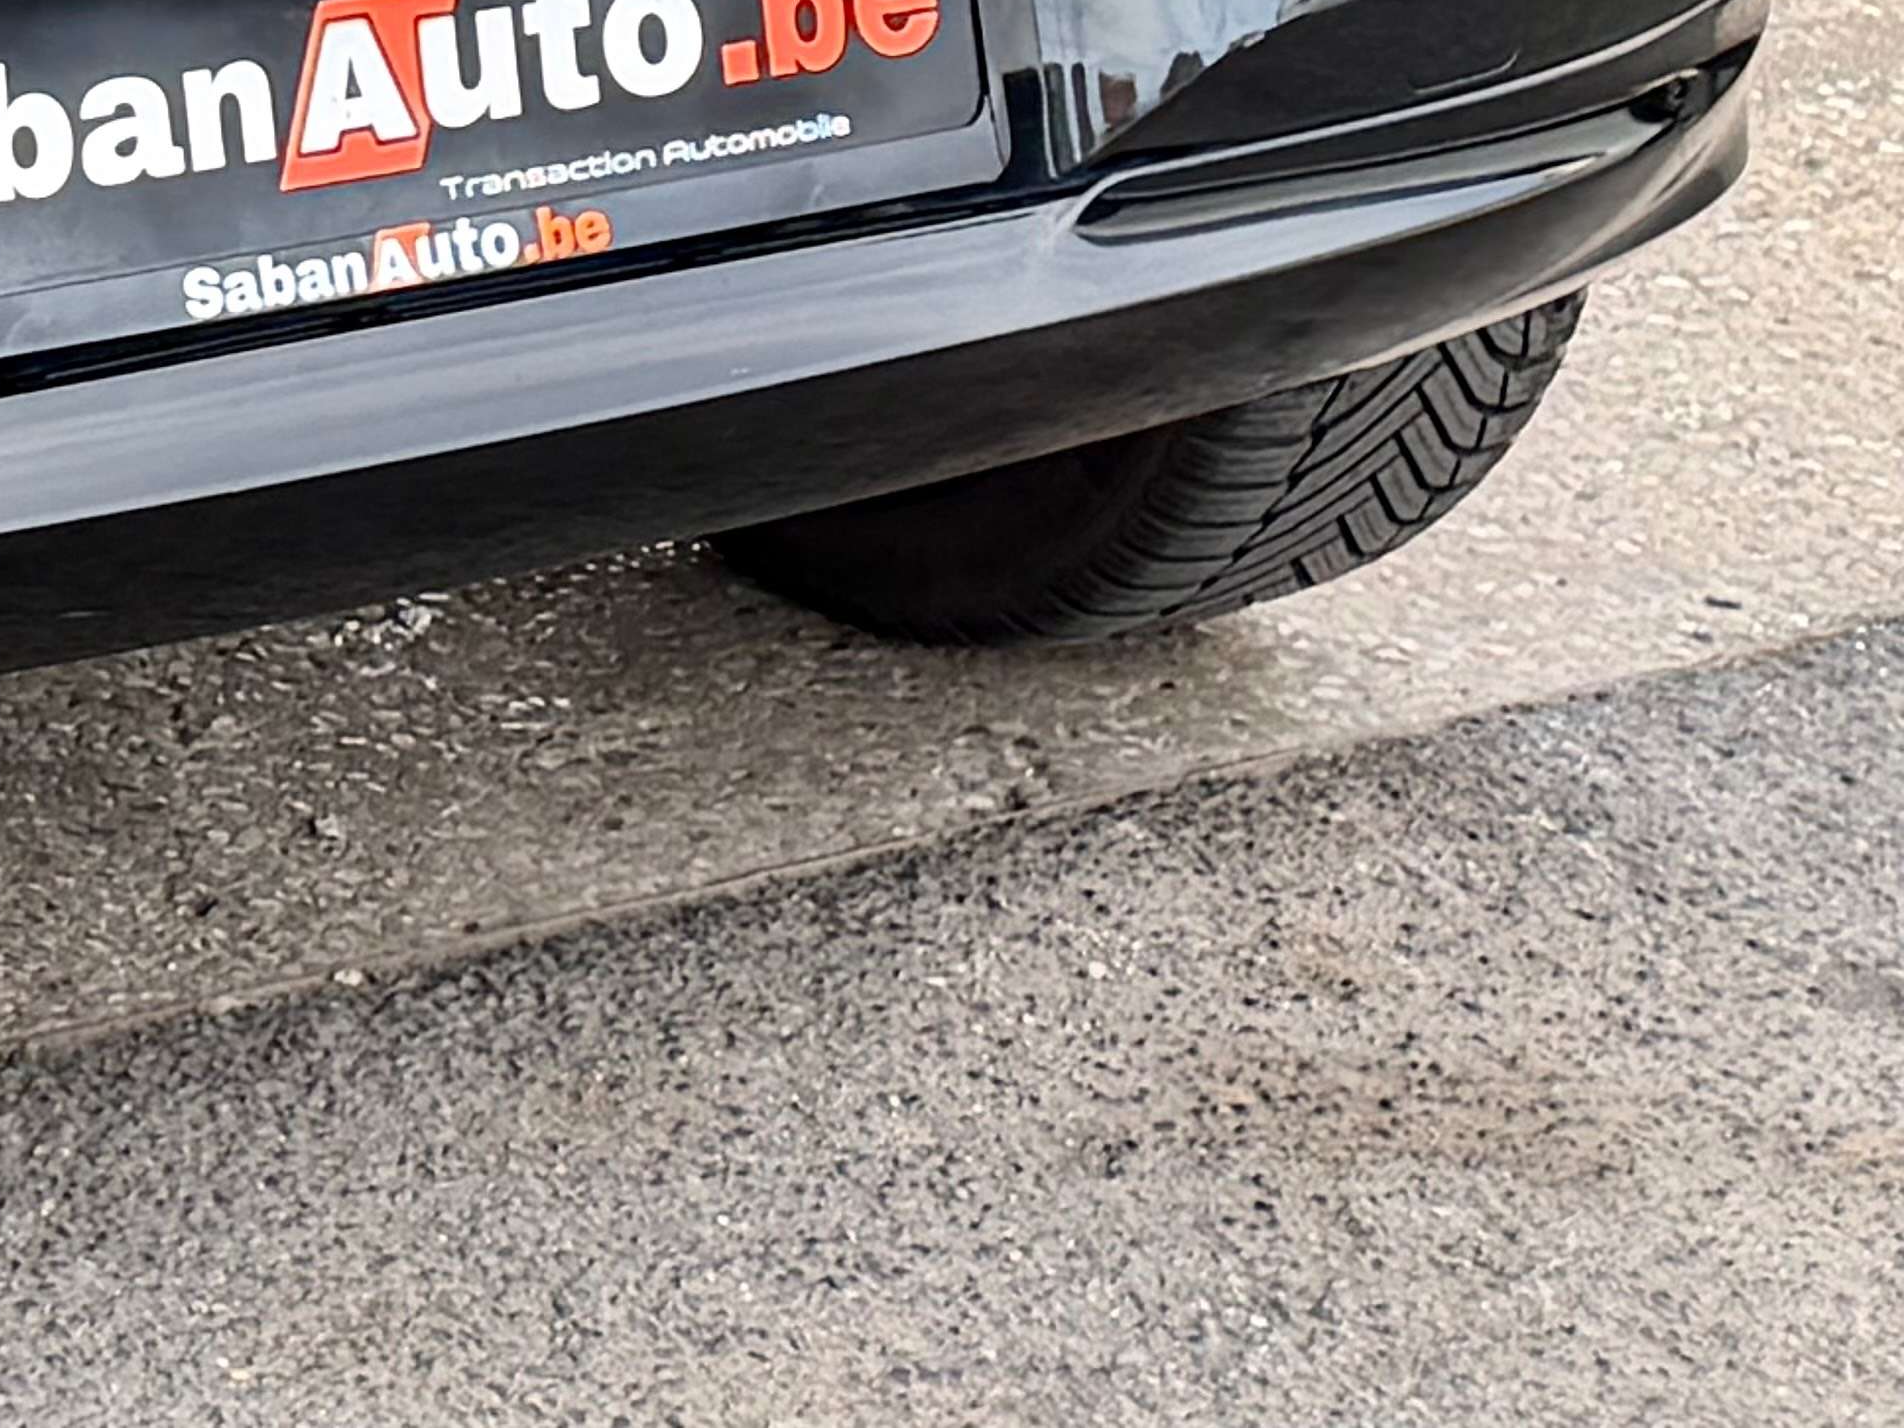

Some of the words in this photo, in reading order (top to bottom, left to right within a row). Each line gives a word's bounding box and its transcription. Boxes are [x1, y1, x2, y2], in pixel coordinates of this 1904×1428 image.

[439, 146, 657, 201] Transaction
[663, 112, 852, 167] Automobile
[181, 205, 615, 320] SabanAuto.be
